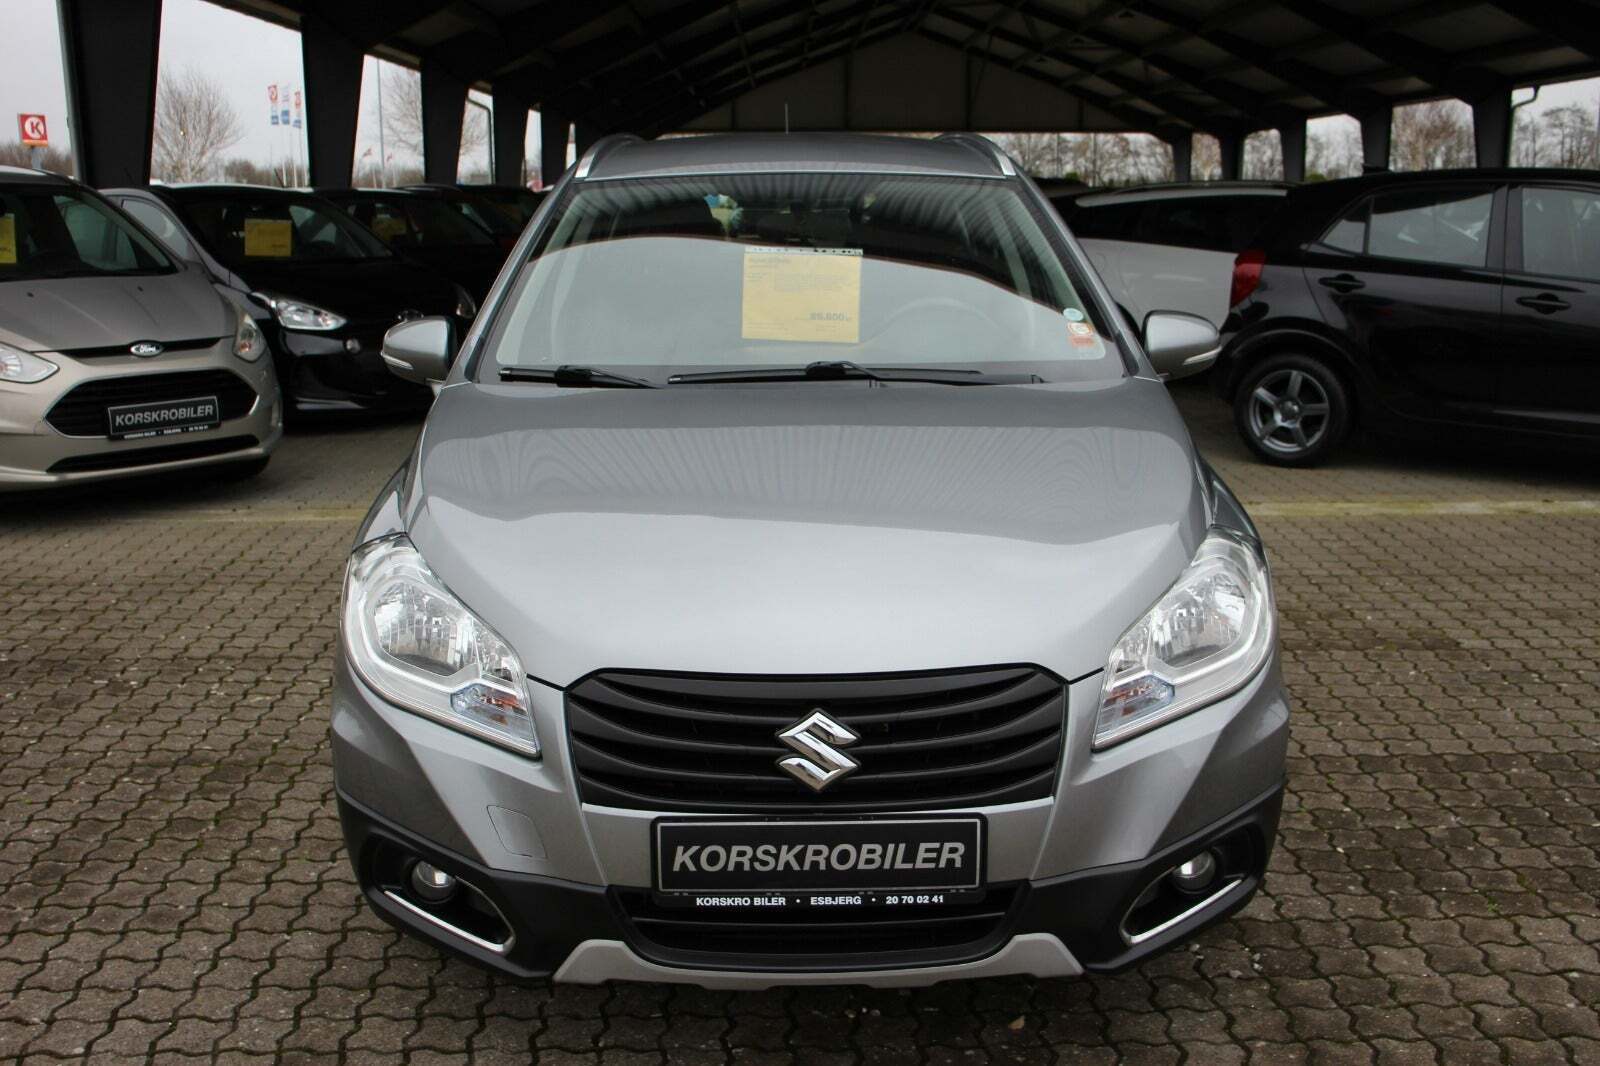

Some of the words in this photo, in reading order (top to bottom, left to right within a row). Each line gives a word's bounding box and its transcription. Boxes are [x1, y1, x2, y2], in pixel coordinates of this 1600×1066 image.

[115, 405, 214, 427] KORSKROBILER
[672, 841, 966, 872] KORSKROBILER
[696, 896, 751, 906] KORSKRO
[753, 896, 787, 906] BILER
[810, 896, 862, 905] ESBJERG
[885, 896, 899, 905] 20
[901, 895, 914, 904] 70
[916, 895, 929, 904] 02
[931, 895, 944, 903] 41
